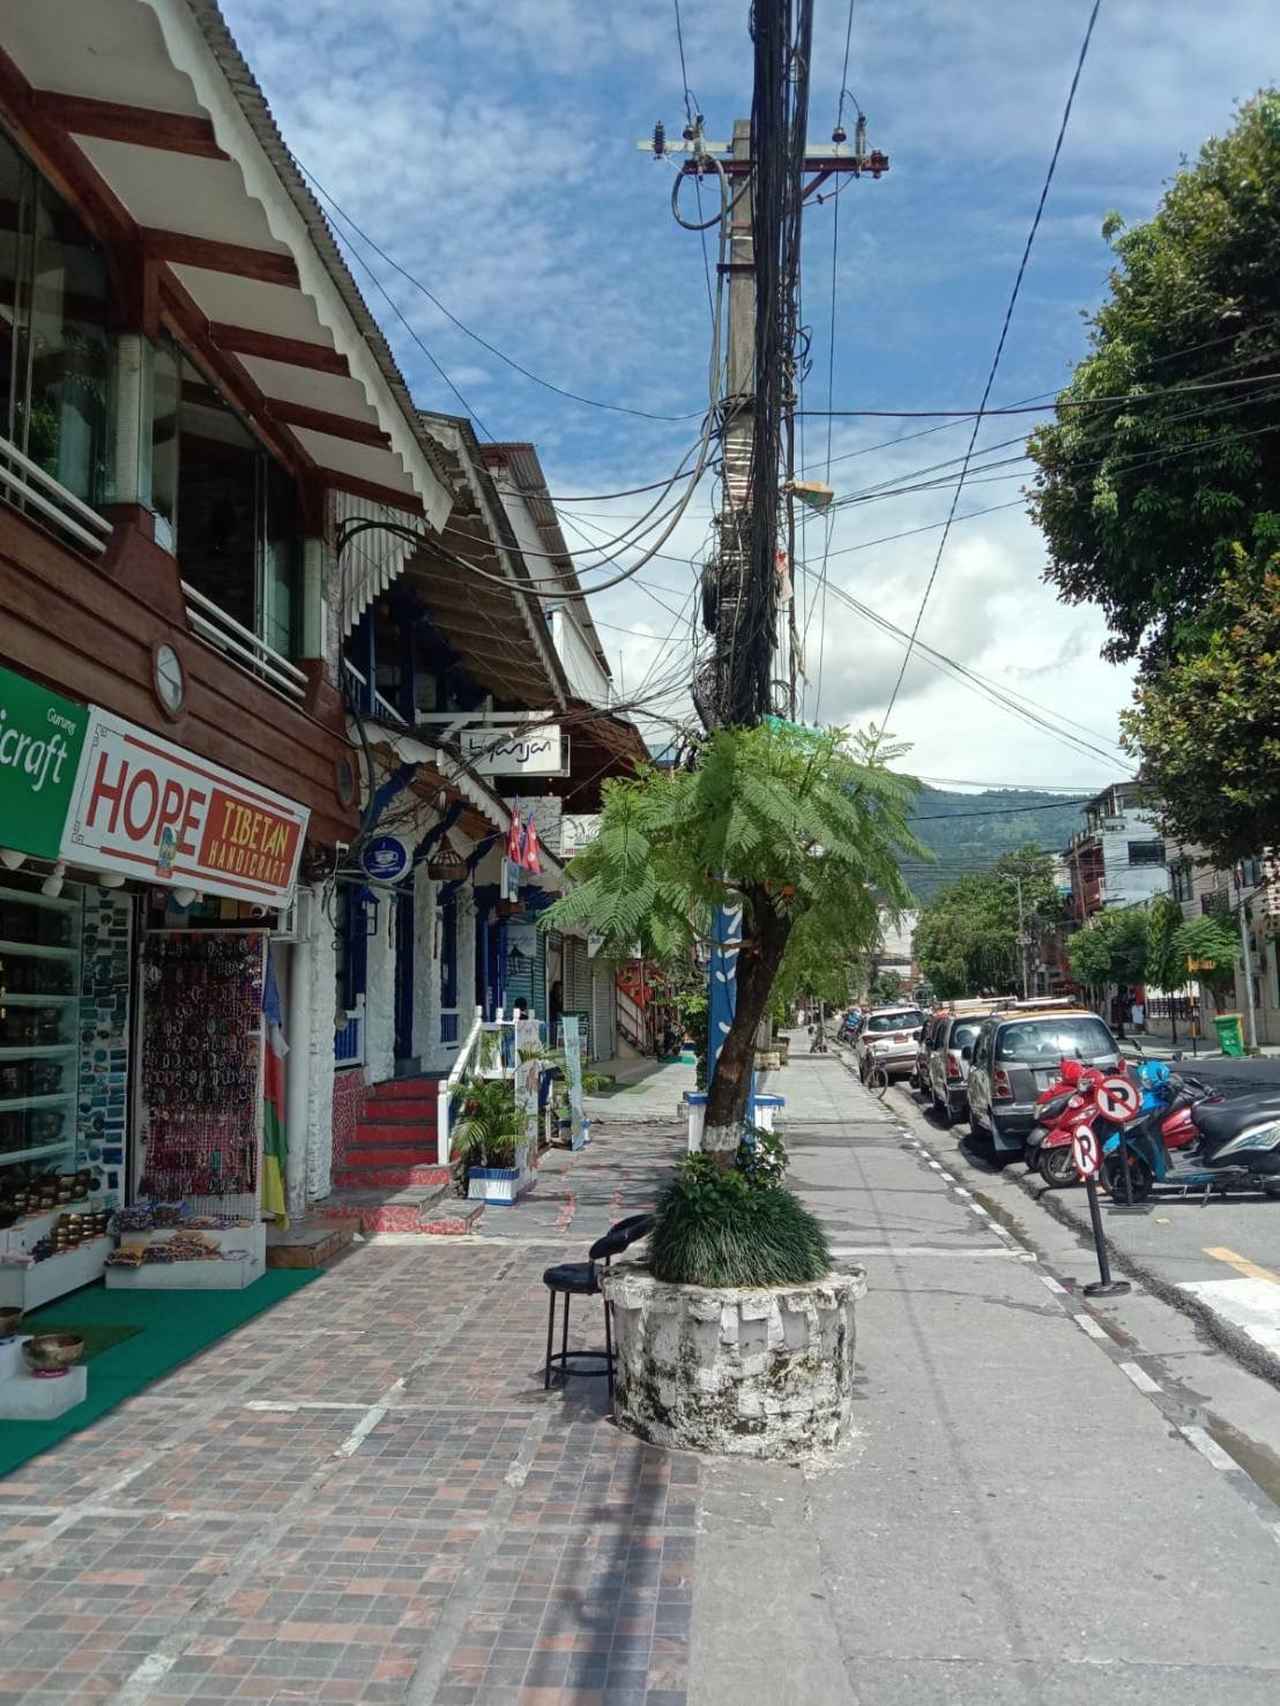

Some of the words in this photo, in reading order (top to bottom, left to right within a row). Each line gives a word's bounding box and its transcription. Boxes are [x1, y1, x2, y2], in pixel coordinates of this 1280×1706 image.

[86, 751, 207, 857] HOPE
[221, 800, 290, 858] TIBETAN
[208, 839, 286, 883] HANDICRAFT
